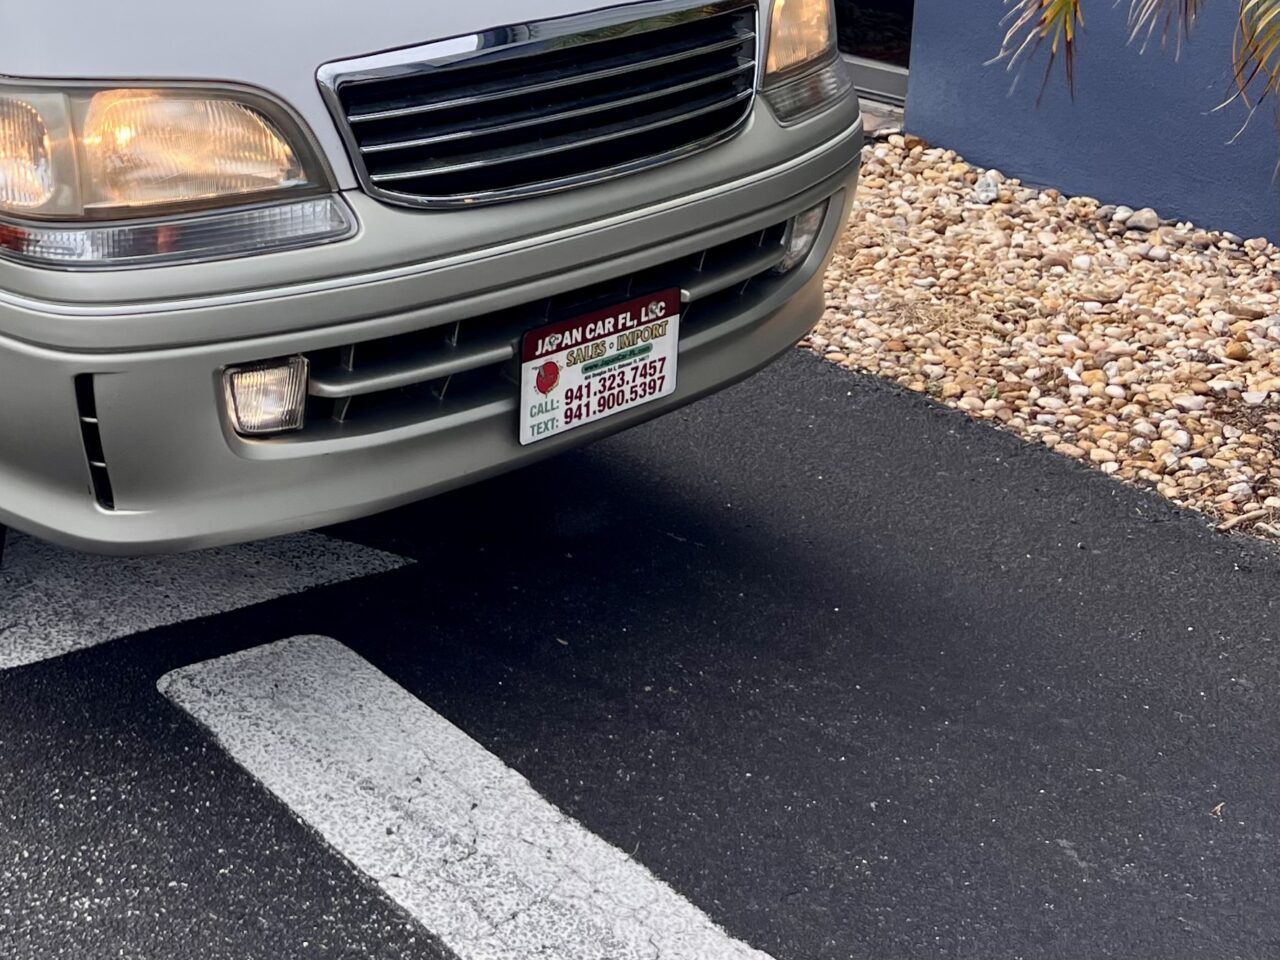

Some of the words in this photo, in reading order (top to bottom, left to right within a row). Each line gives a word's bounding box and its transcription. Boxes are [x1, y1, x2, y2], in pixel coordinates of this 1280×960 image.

[535, 326, 583, 356] JAPAN
[585, 317, 614, 340] CAR
[618, 311, 638, 329] FL,
[566, 340, 607, 368] SALES
[616, 320, 669, 352] IMPORT
[529, 399, 560, 419] CALL:
[564, 356, 667, 406] 941.323.7457
[530, 418, 560, 437] TEXT:
[564, 375, 666, 426] 941.900.5397
